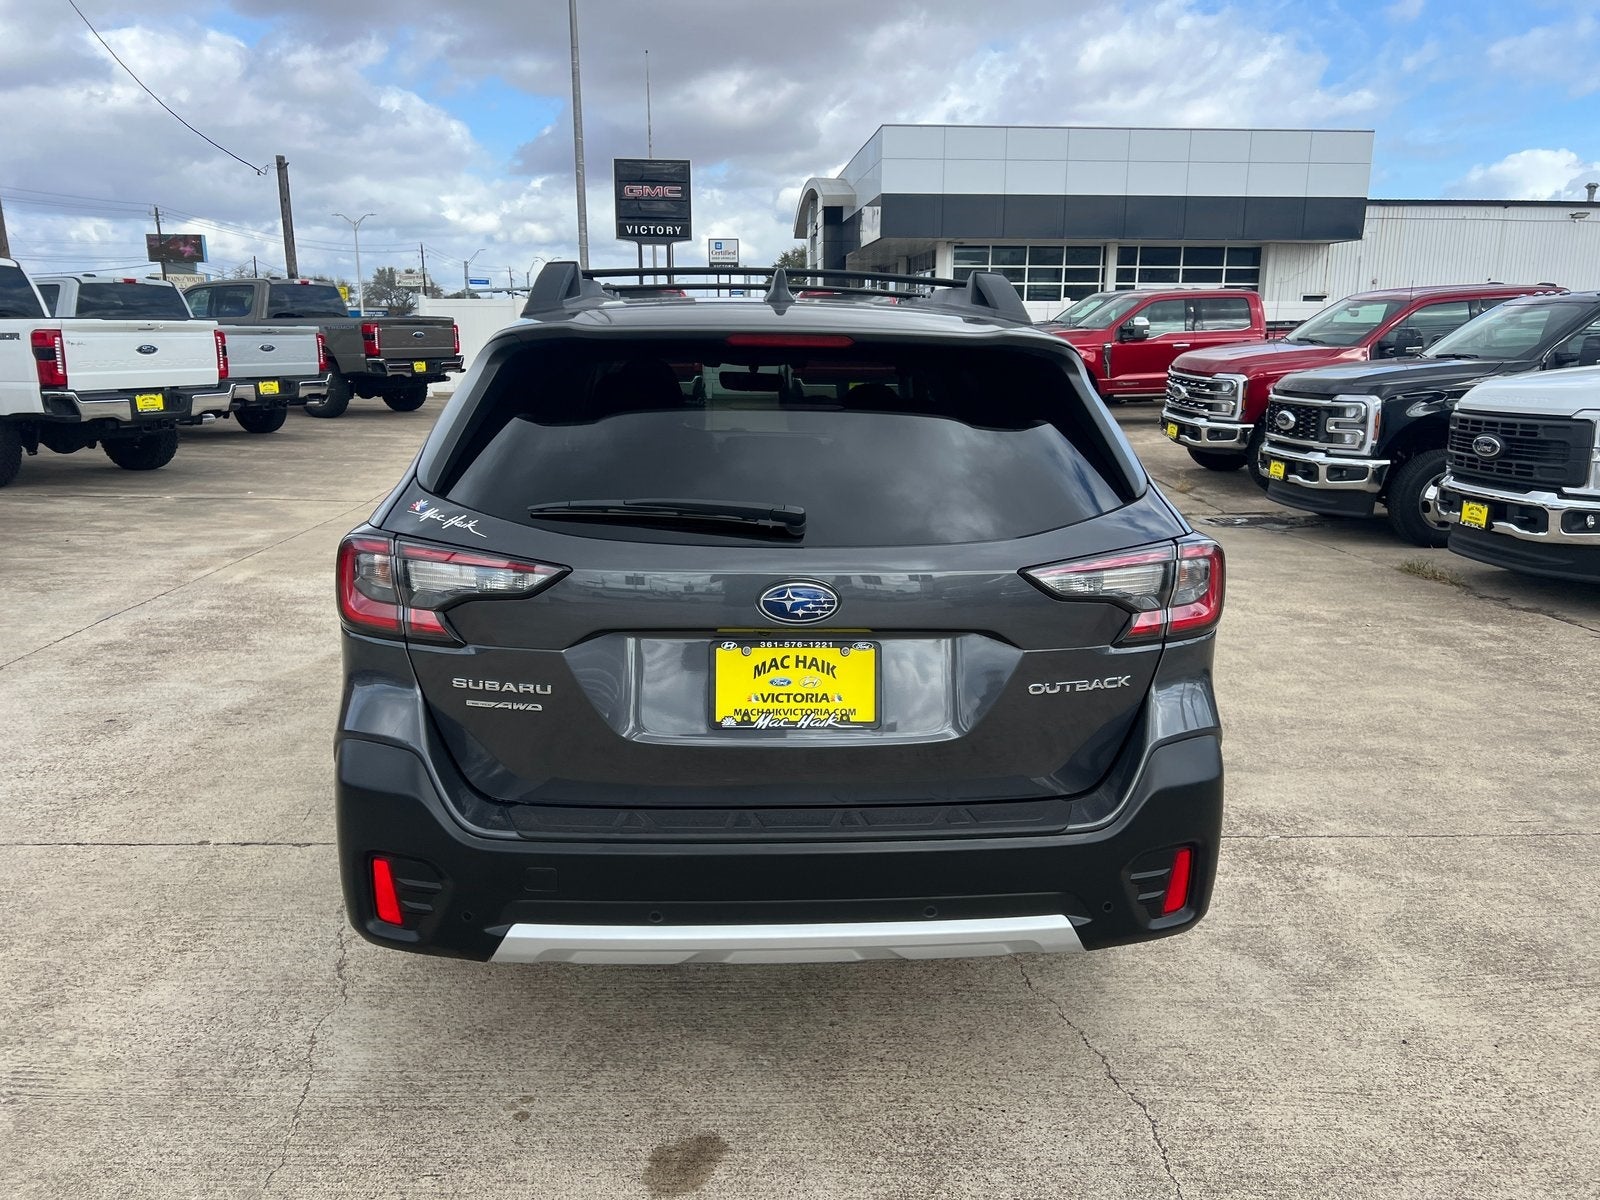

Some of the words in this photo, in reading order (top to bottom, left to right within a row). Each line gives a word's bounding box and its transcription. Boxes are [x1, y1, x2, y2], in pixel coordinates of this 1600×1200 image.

[624, 185, 682, 198] GMC
[626, 225, 682, 235] VICTORY
[442, 515, 486, 537] Haik
[753, 655, 790, 679] MAC
[795, 655, 837, 679] HAIK
[452, 677, 552, 695] SUBARU
[1028, 675, 1131, 695] OUTBACK
[494, 701, 543, 711] AWD
[760, 693, 830, 703] VICTORIA
[754, 712, 792, 729] Mac
[796, 712, 842, 729] Haik
